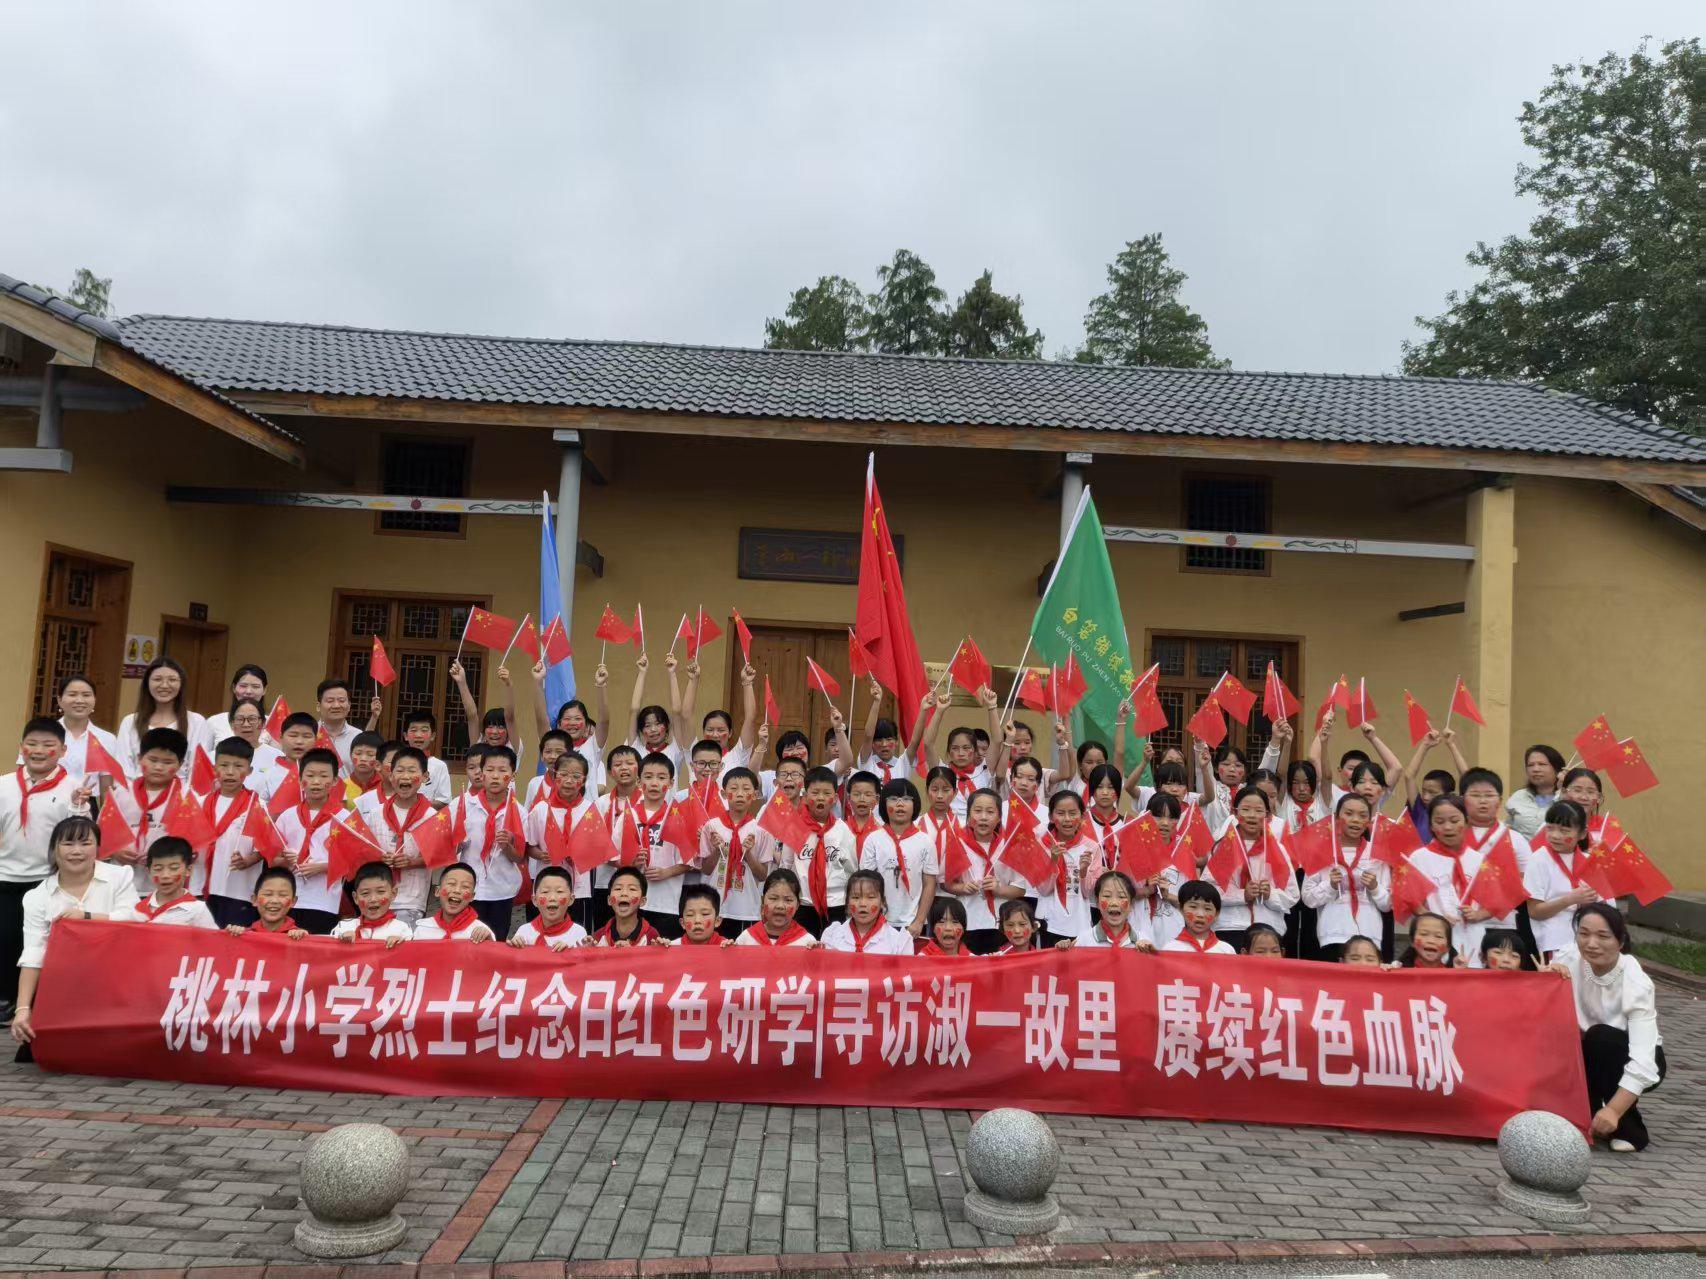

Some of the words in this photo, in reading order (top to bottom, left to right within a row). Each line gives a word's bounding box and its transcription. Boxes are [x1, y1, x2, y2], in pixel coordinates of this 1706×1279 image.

[1155, 979, 1463, 1095] 赓续红色血脉
